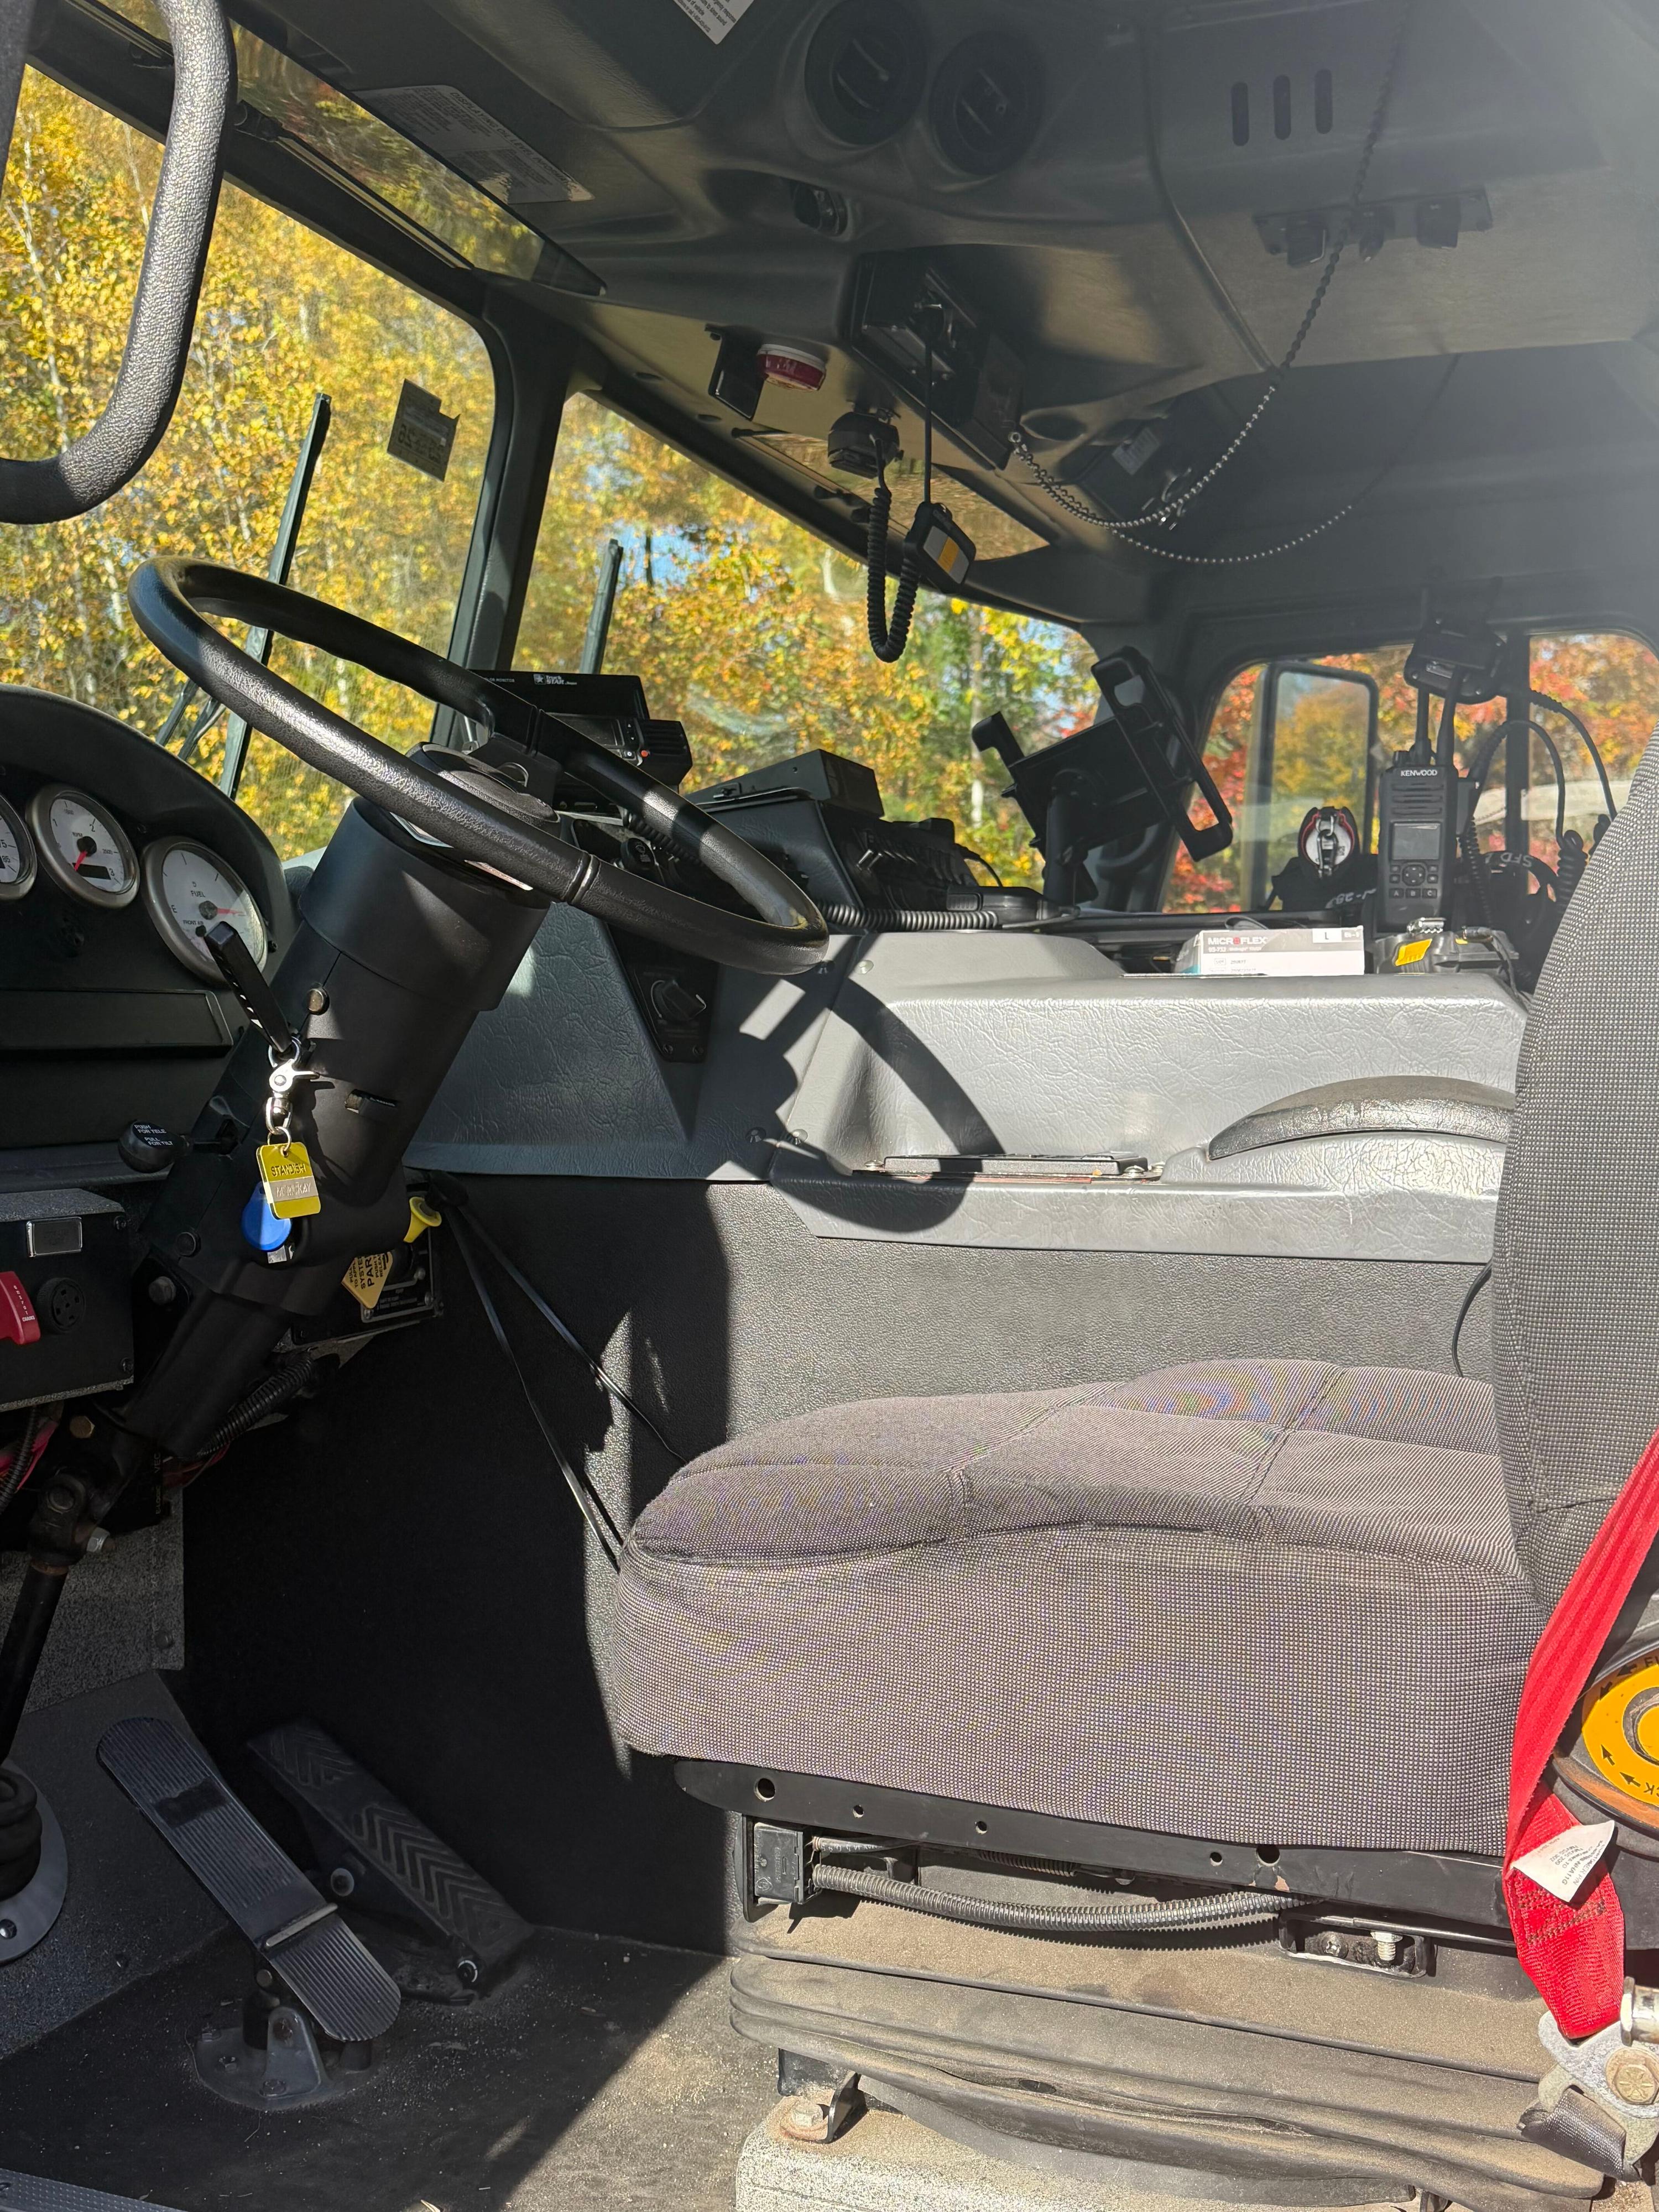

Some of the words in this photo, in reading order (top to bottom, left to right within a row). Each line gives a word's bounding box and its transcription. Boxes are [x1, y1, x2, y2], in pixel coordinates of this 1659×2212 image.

[692, 3, 706, 16] vehicle
[716, 14, 727, 26] sound
[450, 90, 501, 130] DISPLAYING
[496, 126, 513, 140] OIL
[509, 135, 534, 156] LEVEL
[89, 824, 96, 832] 2
[109, 868, 115, 877] 3
[171, 905, 178, 914] E
[1208, 936, 1267, 946] MICROFLEX
[1324, 932, 1329, 940] L
[271, 1163, 306, 1177] STANDISH
[365, 1257, 374, 1286] PAR
[354, 1279, 358, 1287] TO
[1572, 1874, 1583, 1886] P/N
